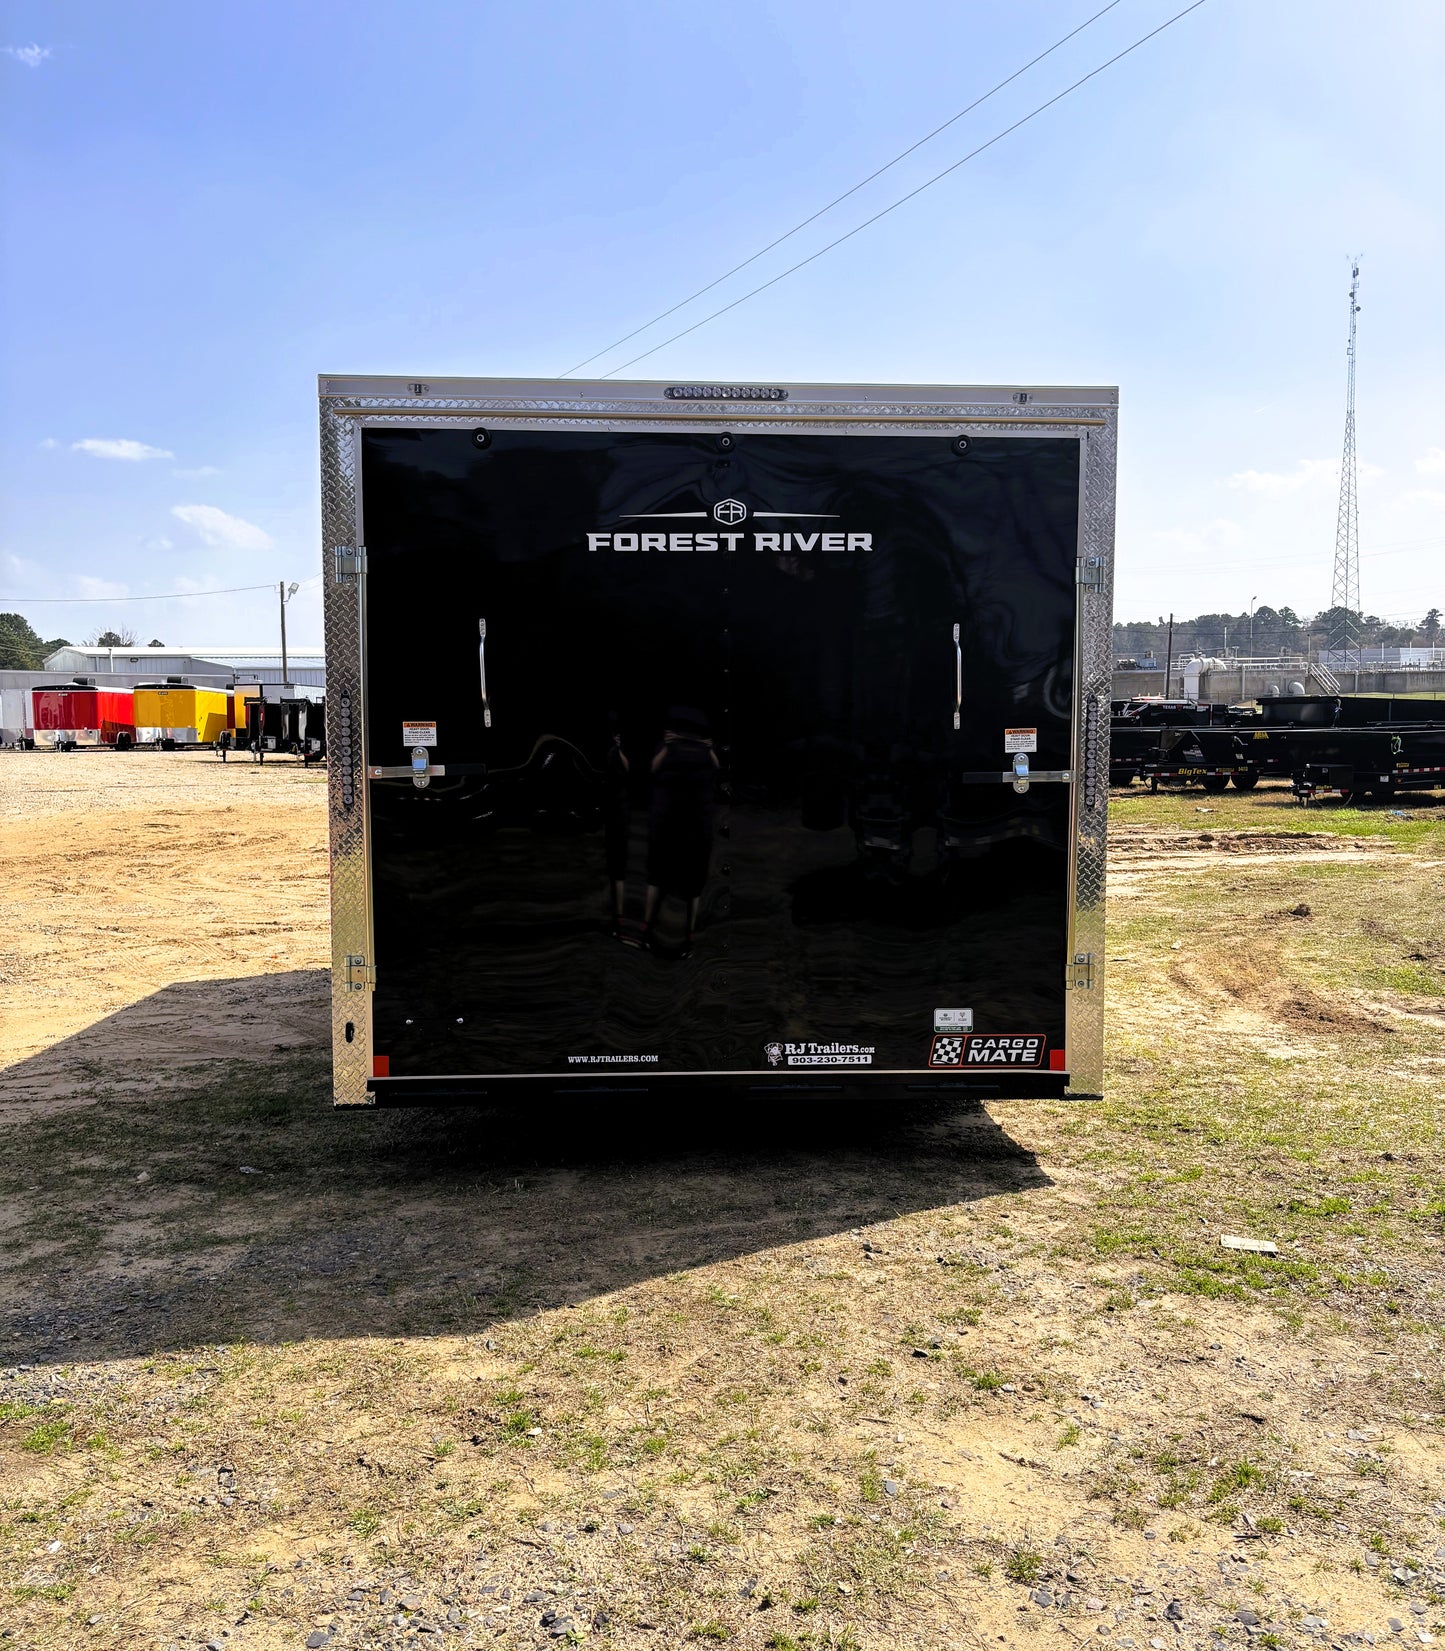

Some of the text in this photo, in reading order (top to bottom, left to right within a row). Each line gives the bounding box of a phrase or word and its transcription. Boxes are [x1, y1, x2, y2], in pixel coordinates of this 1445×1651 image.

[586, 532, 873, 552] FOREST RIVER
[1178, 767, 1208, 776] BigTex
[784, 1043, 806, 1055] RJ
[970, 1038, 1039, 1049] CARGO
[567, 1055, 659, 1064] WWW.RJTRAILERS.COM
[792, 1055, 868, 1064] 903-230-7511
[967, 1049, 1036, 1062] MATE
